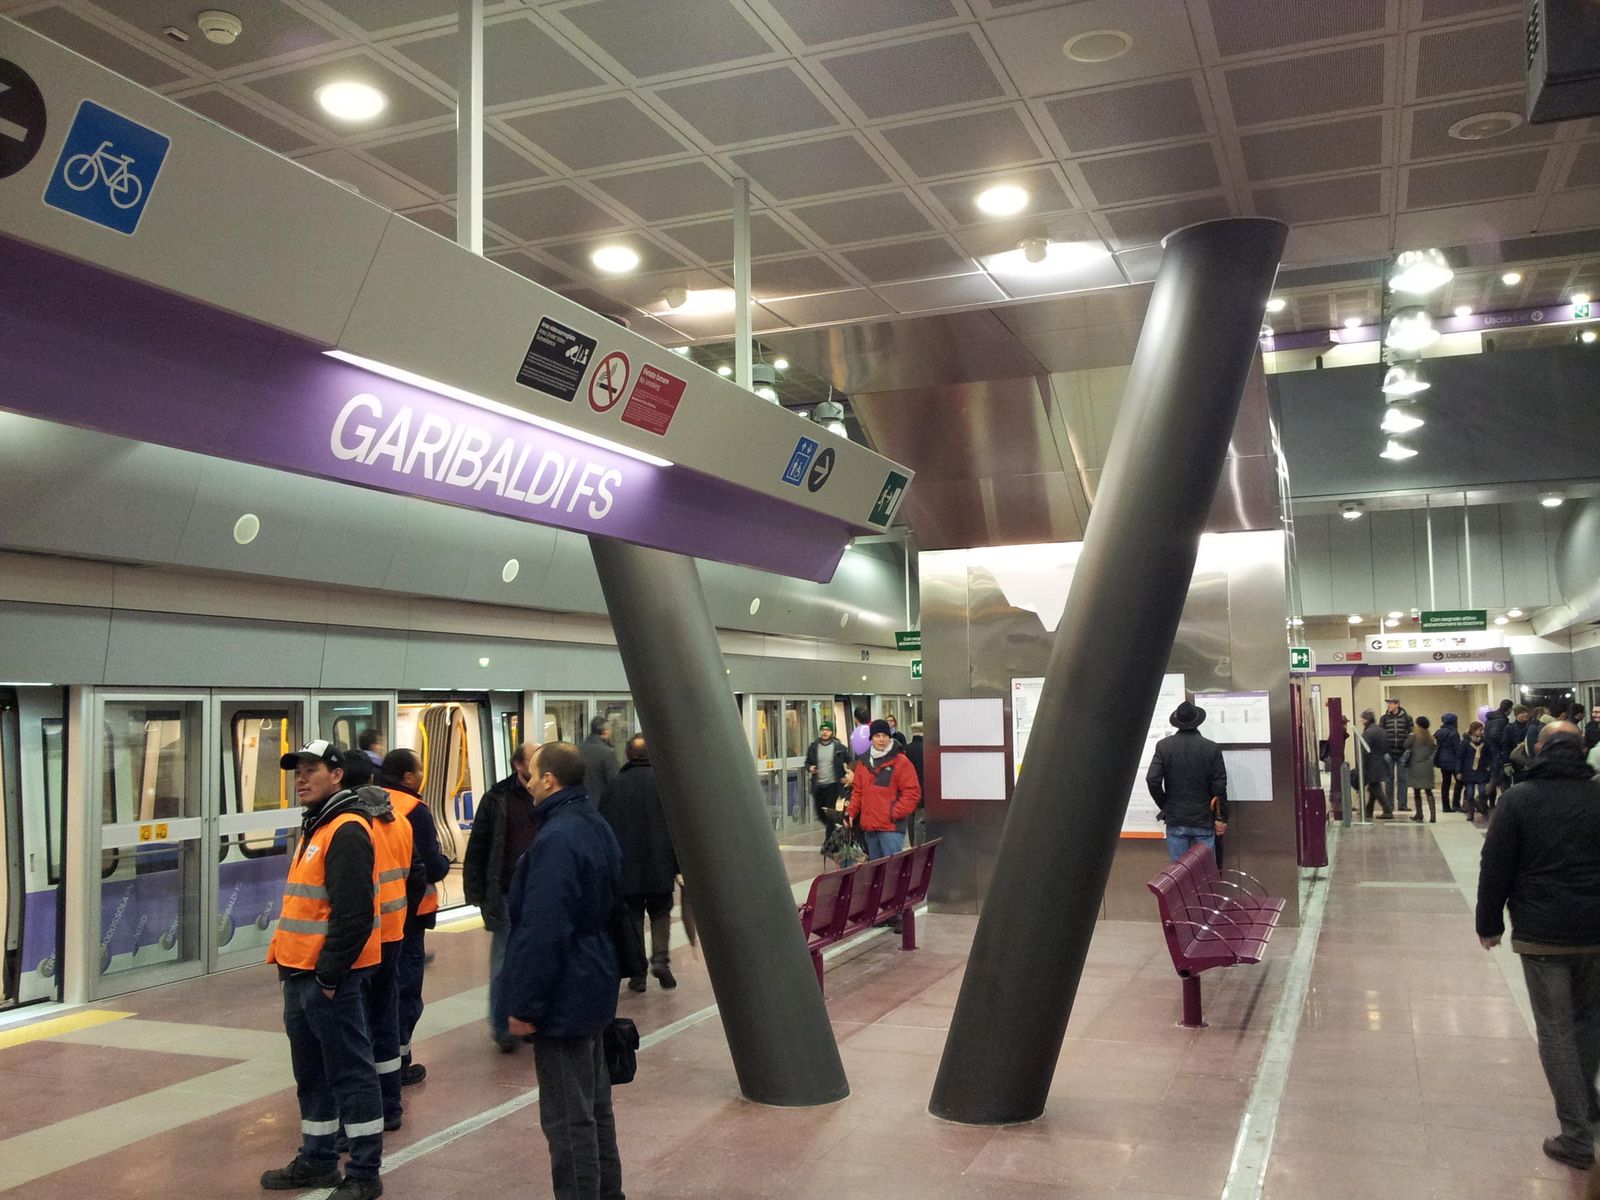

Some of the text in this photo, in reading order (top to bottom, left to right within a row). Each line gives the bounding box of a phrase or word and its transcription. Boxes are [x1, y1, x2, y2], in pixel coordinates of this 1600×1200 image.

[330, 393, 576, 509] GARIBALDI
[567, 462, 622, 519] FS
[1446, 651, 1472, 660] Uscita
